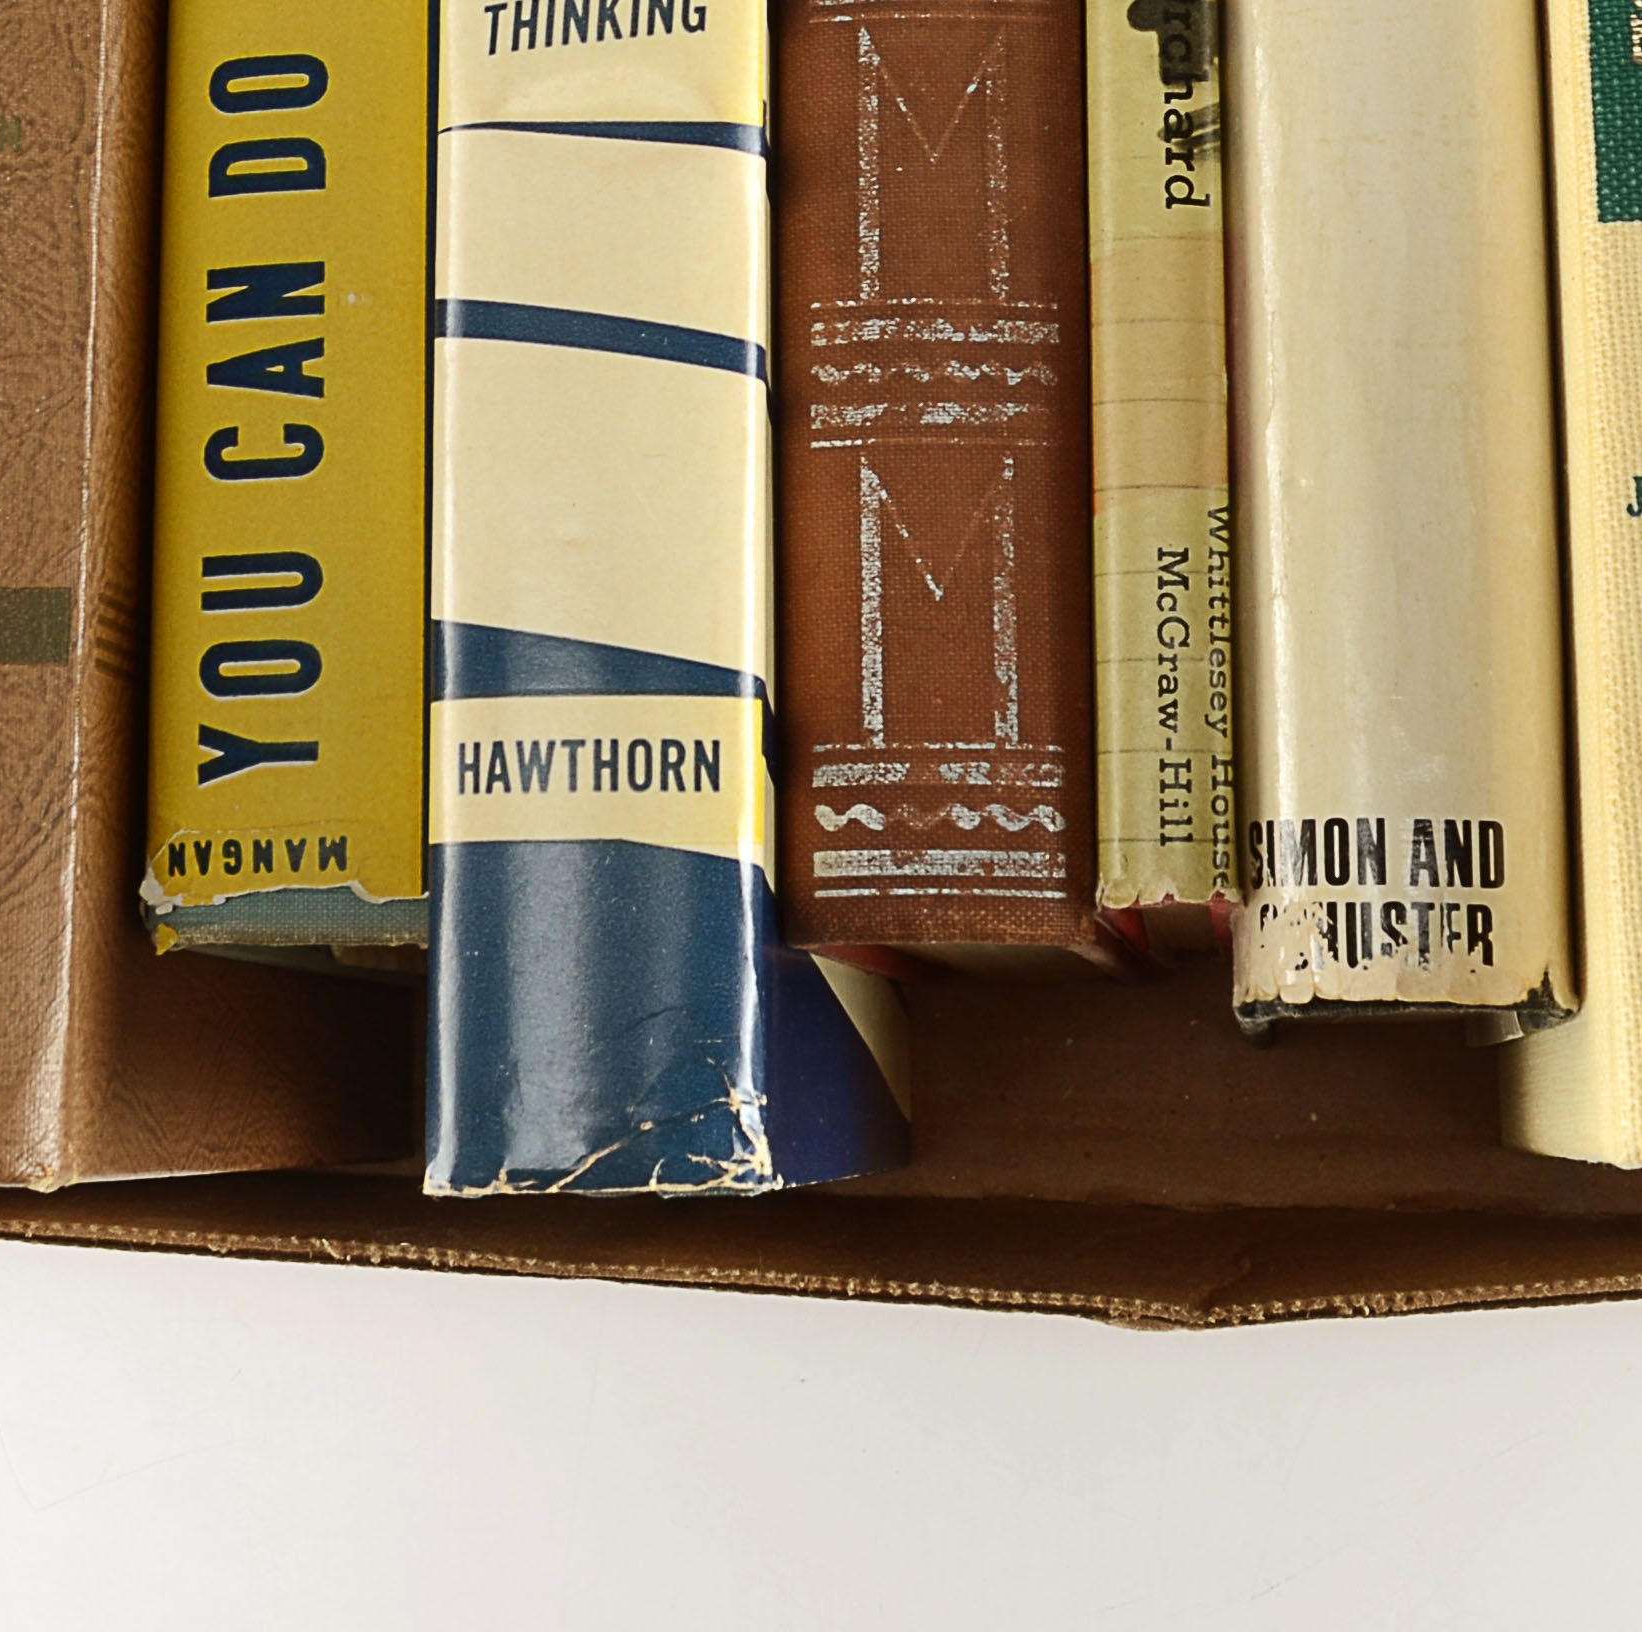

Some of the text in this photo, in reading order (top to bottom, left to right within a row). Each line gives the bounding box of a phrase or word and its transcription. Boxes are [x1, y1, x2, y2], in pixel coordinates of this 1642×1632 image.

[207, 52, 330, 199] DO
[203, 259, 327, 482] CAN
[197, 550, 325, 789] YOU
[1156, 546, 1193, 848] McGraw-Hill
[1204, 505, 1234, 889] Whittlesey House
[166, 834, 348, 878] MANGAN
[457, 737, 721, 795] HAWTHORN
[1248, 817, 1506, 891] SIMON AND
